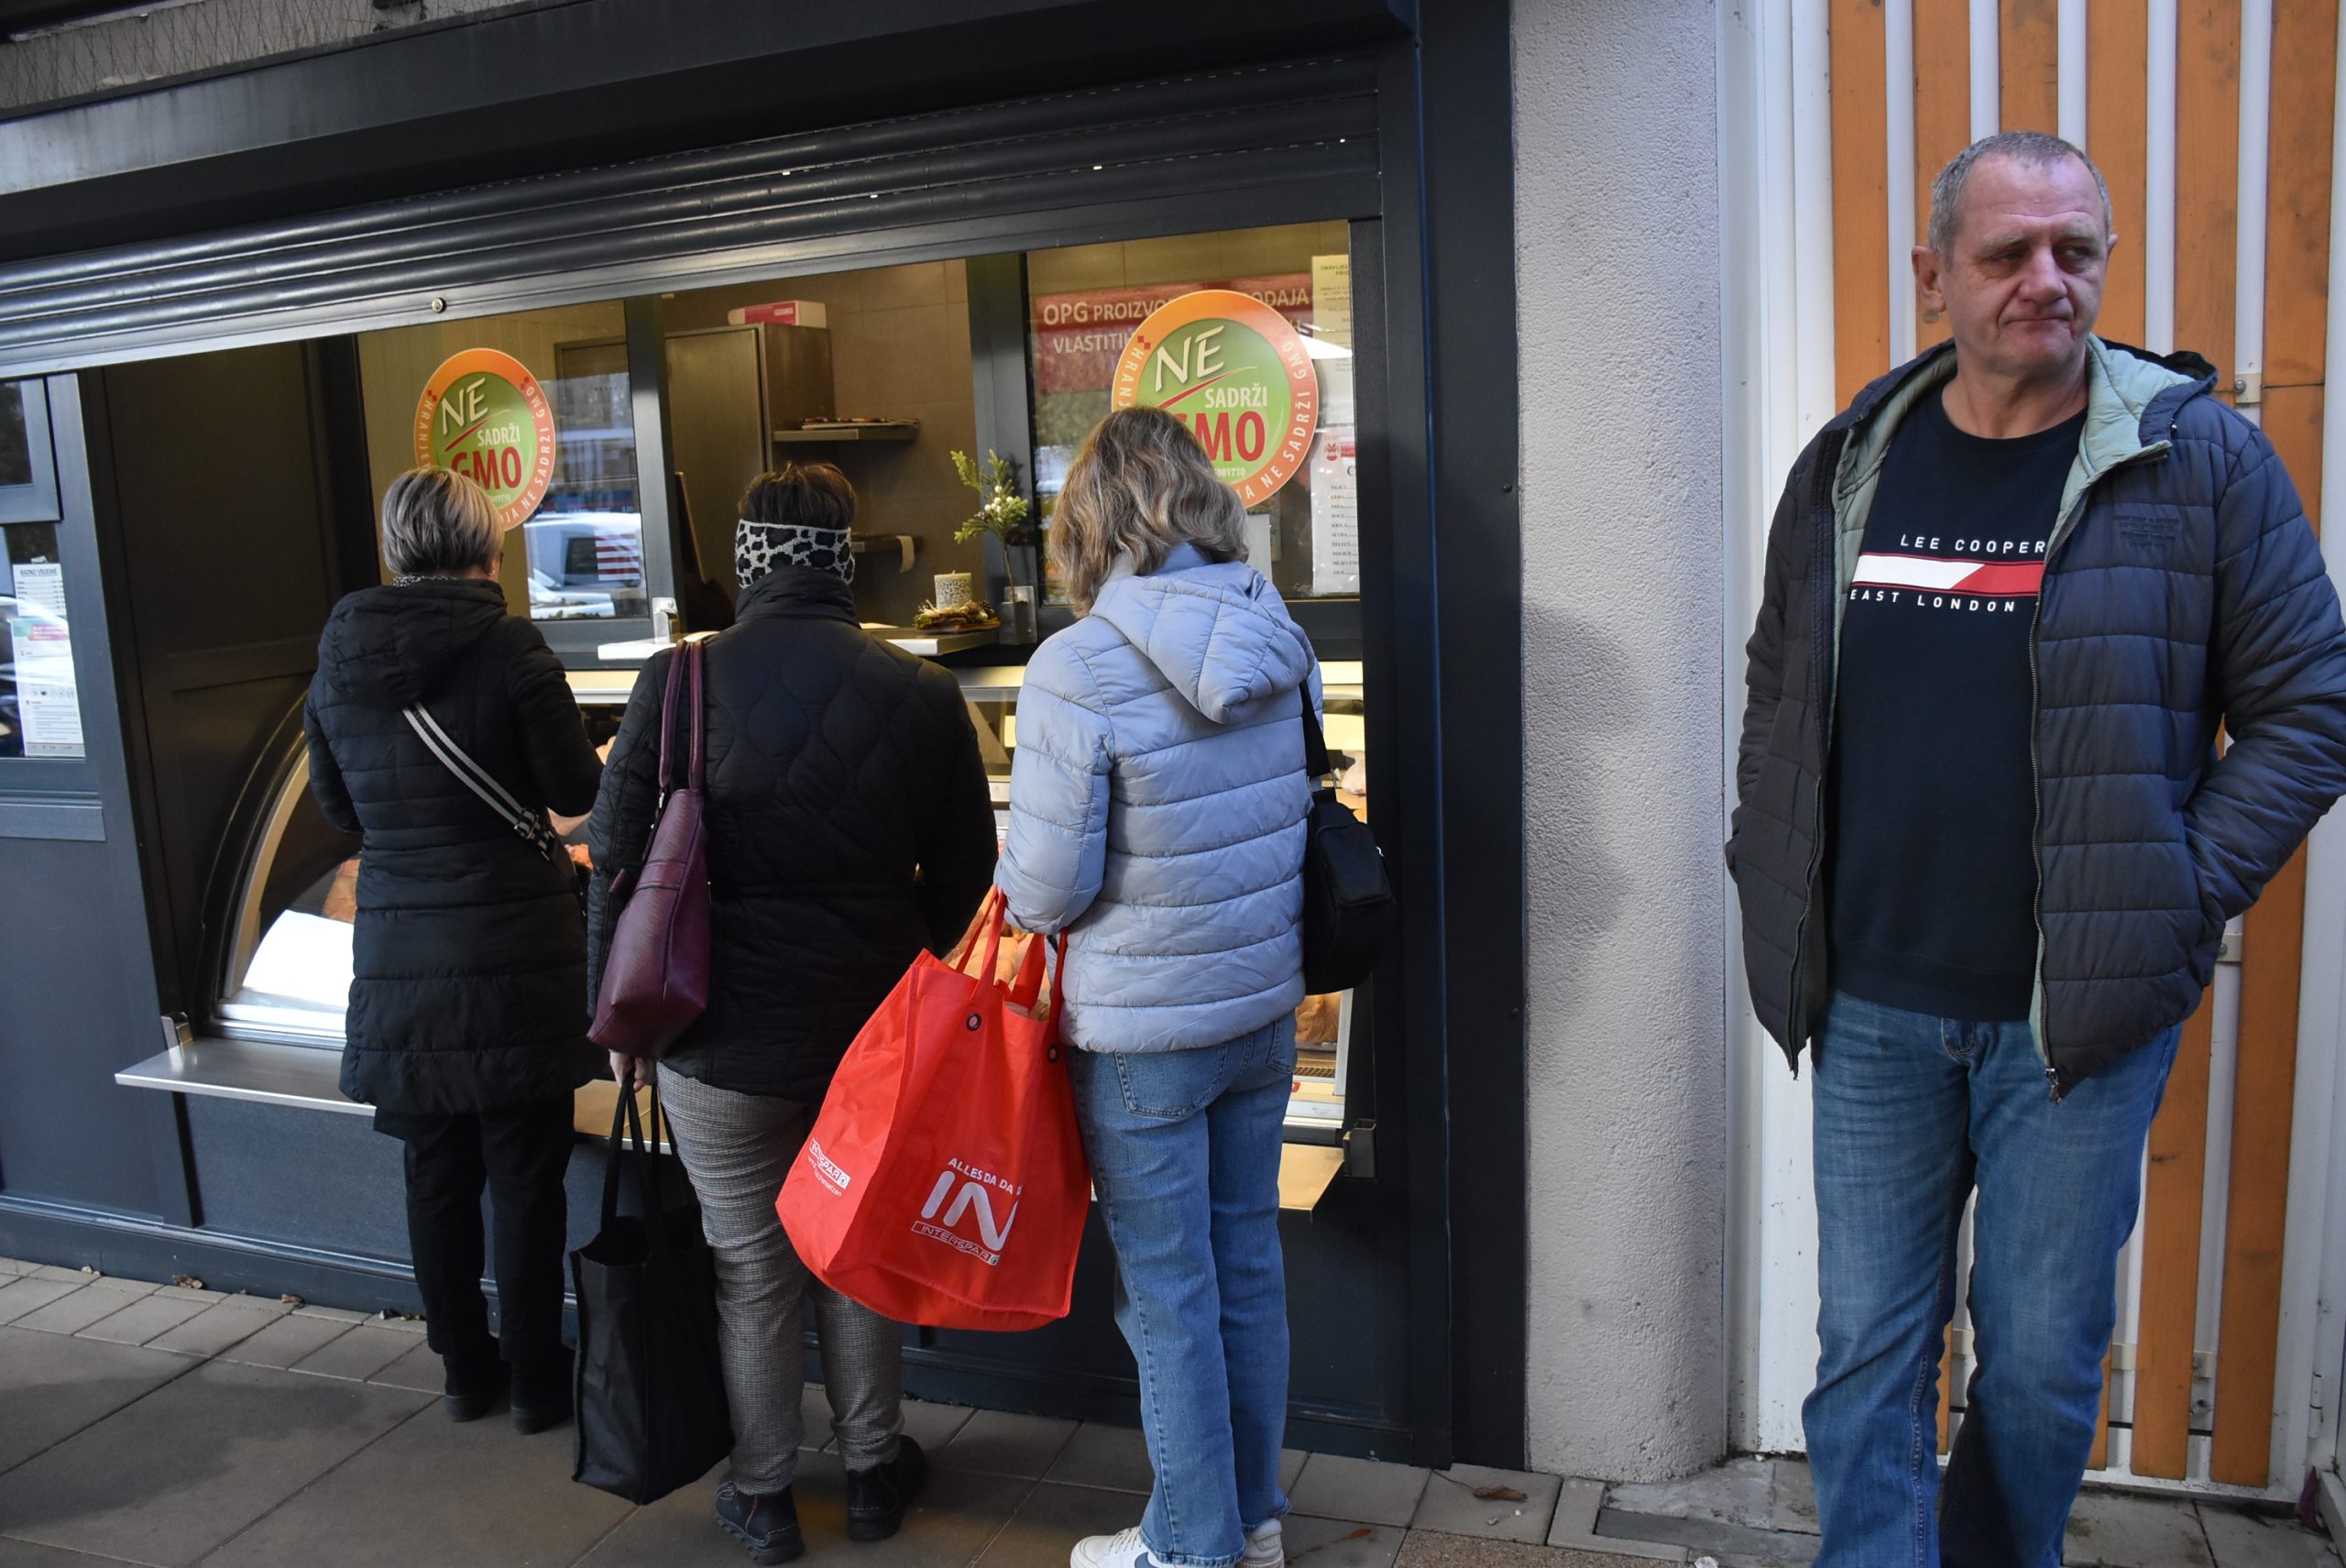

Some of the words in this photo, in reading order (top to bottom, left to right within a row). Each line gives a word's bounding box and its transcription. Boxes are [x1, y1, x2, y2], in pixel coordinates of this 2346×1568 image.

[1043, 302, 1089, 325] OPG
[1093, 299, 1173, 322] PROIZVO
[1155, 325, 1225, 392] NE
[1282, 340, 1307, 380] GMO
[441, 377, 488, 435] NE
[526, 386, 546, 419] GMO
[1204, 382, 1268, 409] SADRŽI
[477, 422, 521, 446] SADRŽI
[1175, 411, 1266, 463] MO
[1283, 391, 1311, 463] SADRŽI
[1260, 465, 1283, 488] NE
[521, 490, 537, 510] NE
[1900, 533, 1940, 550] LEE
[1955, 539, 2045, 554] COOPER
[1849, 588, 1900, 603] EAST
[1917, 594, 2015, 612] LONDON
[948, 1157, 983, 1180] ALLES
[983, 1172, 997, 1186] DA
[999, 1179, 1014, 1195] DA
[921, 1169, 1019, 1252] IN
[921, 1224, 990, 1261] INTERSPAR
